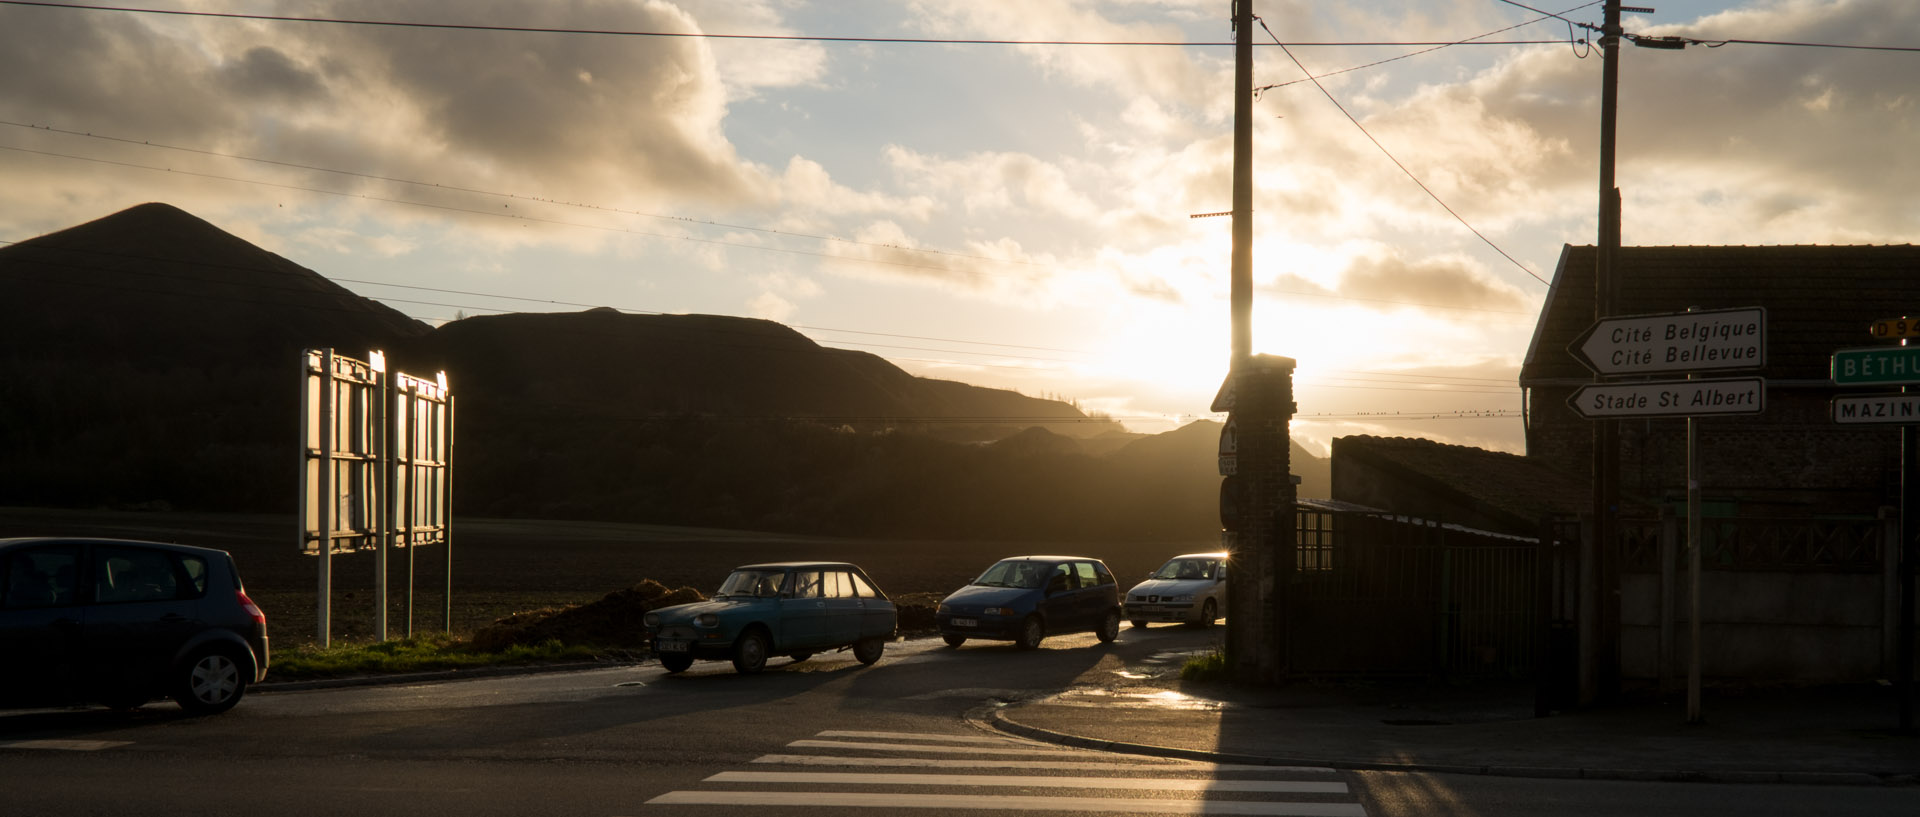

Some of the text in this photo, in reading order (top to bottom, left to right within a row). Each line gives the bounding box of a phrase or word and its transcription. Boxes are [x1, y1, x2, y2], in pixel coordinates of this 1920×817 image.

[1611, 321, 1756, 344] Cité Belgique
[1878, 323, 1888, 336] D
[1611, 345, 1756, 366] Cité Bellevue
[1594, 389, 1754, 410] Stade St Albert
[1842, 401, 1920, 417] MAZIN
